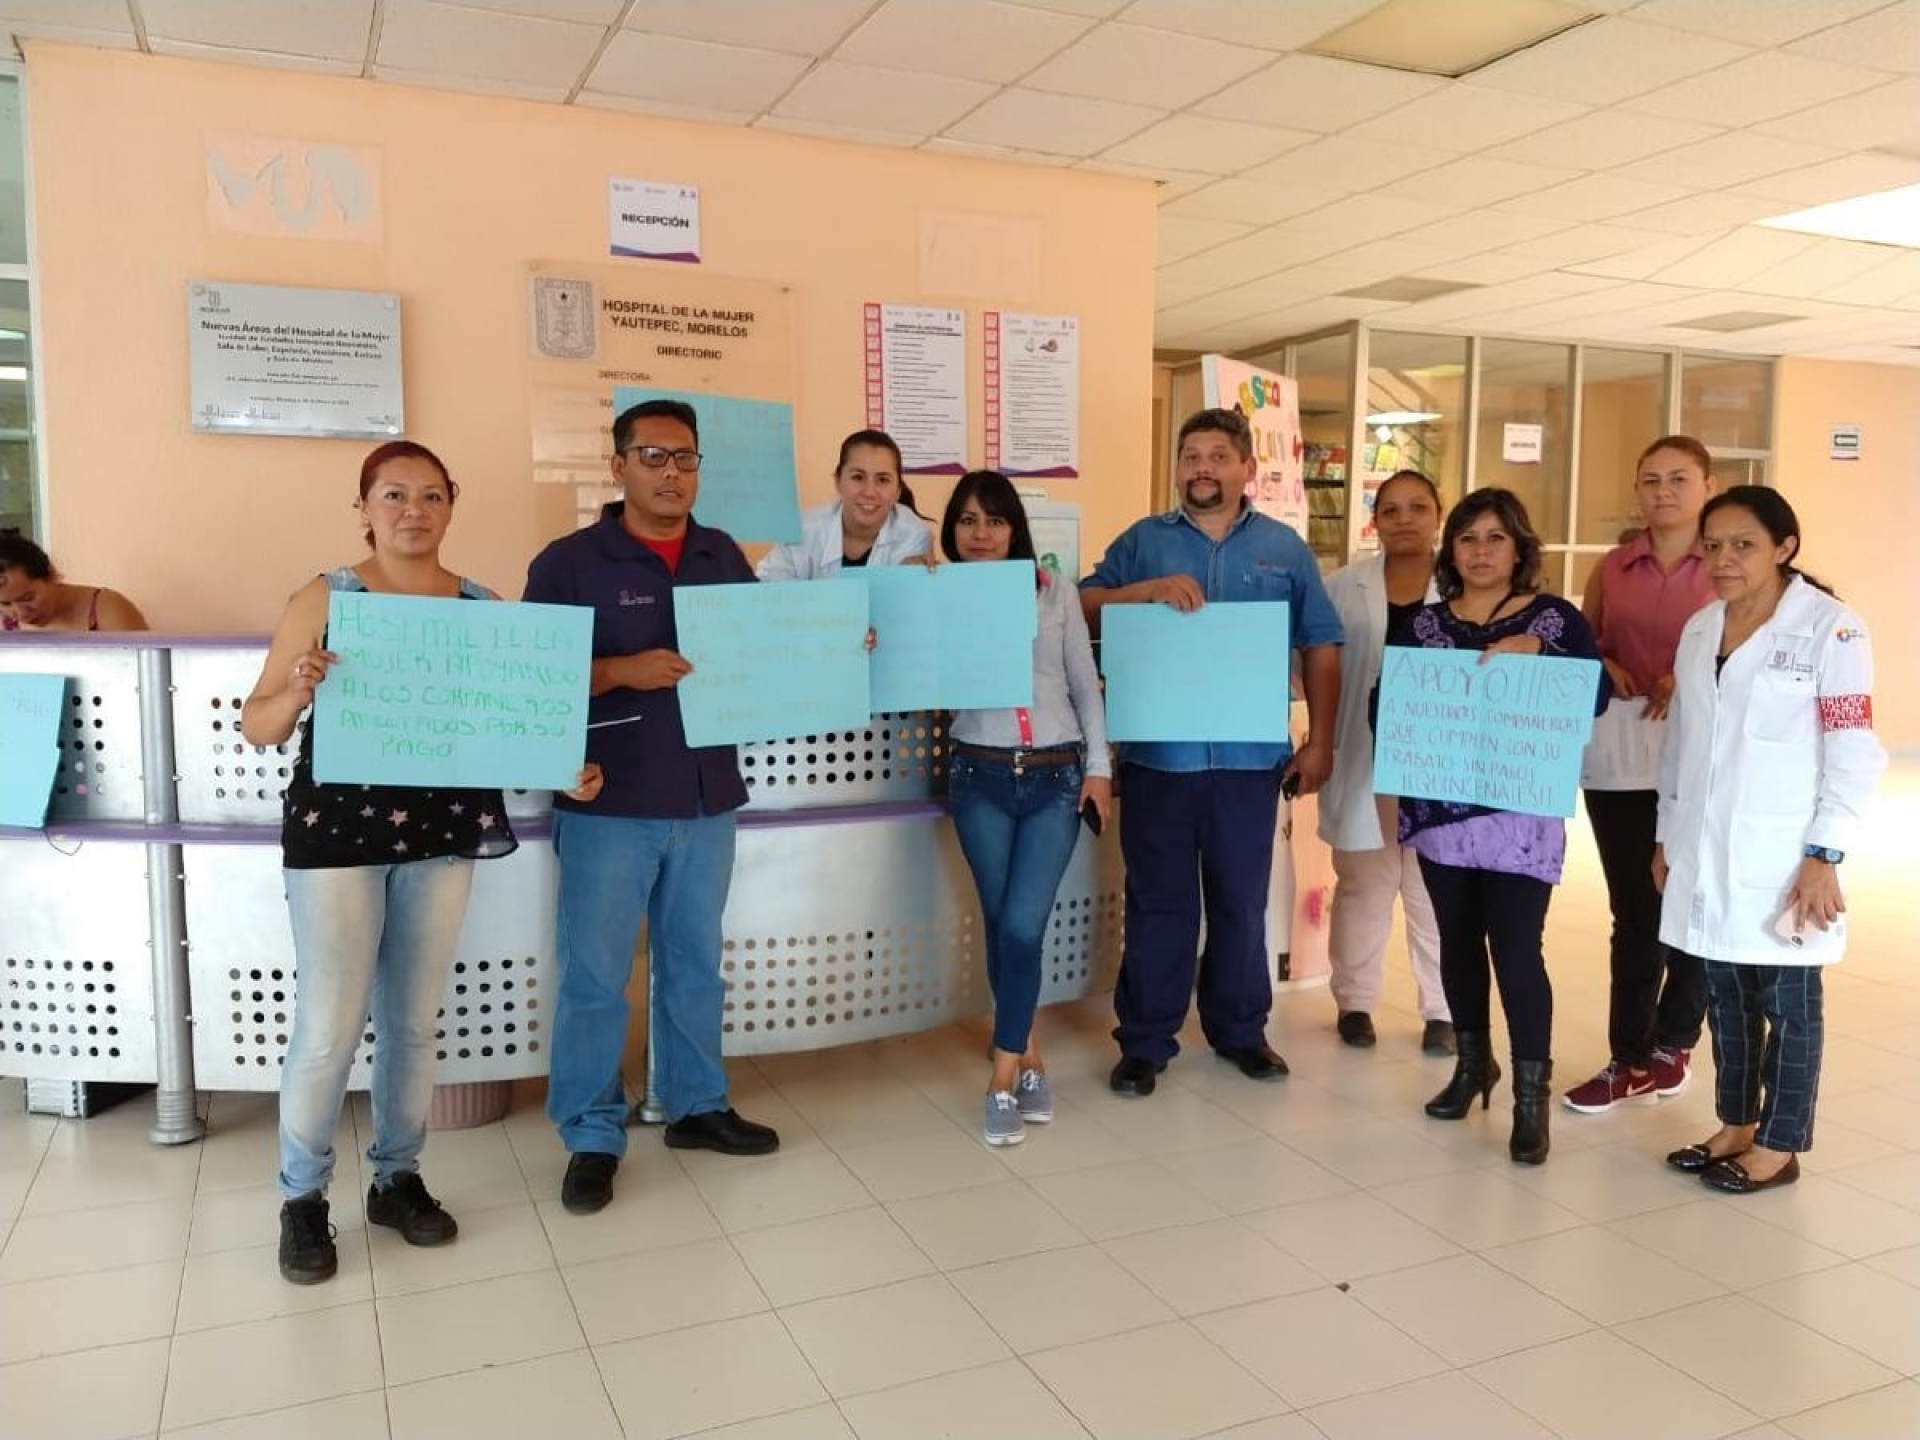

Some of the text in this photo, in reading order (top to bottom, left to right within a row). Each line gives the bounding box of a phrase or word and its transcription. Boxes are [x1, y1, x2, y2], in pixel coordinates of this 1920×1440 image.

[603, 299, 755, 322] HOSPITAL DE LA MUJER
[201, 320, 240, 332] Nuevas
[274, 324, 290, 335] del
[292, 326, 335, 339] Hospital
[336, 329, 349, 339] de
[351, 331, 361, 340] la
[362, 332, 390, 343] Mujer
[611, 315, 748, 337] YAUTEPEC, MORELOS
[656, 345, 722, 360] DIRECTORIO
[1383, 721, 1417, 744] QUE
[381, 736, 454, 758] PAGO
